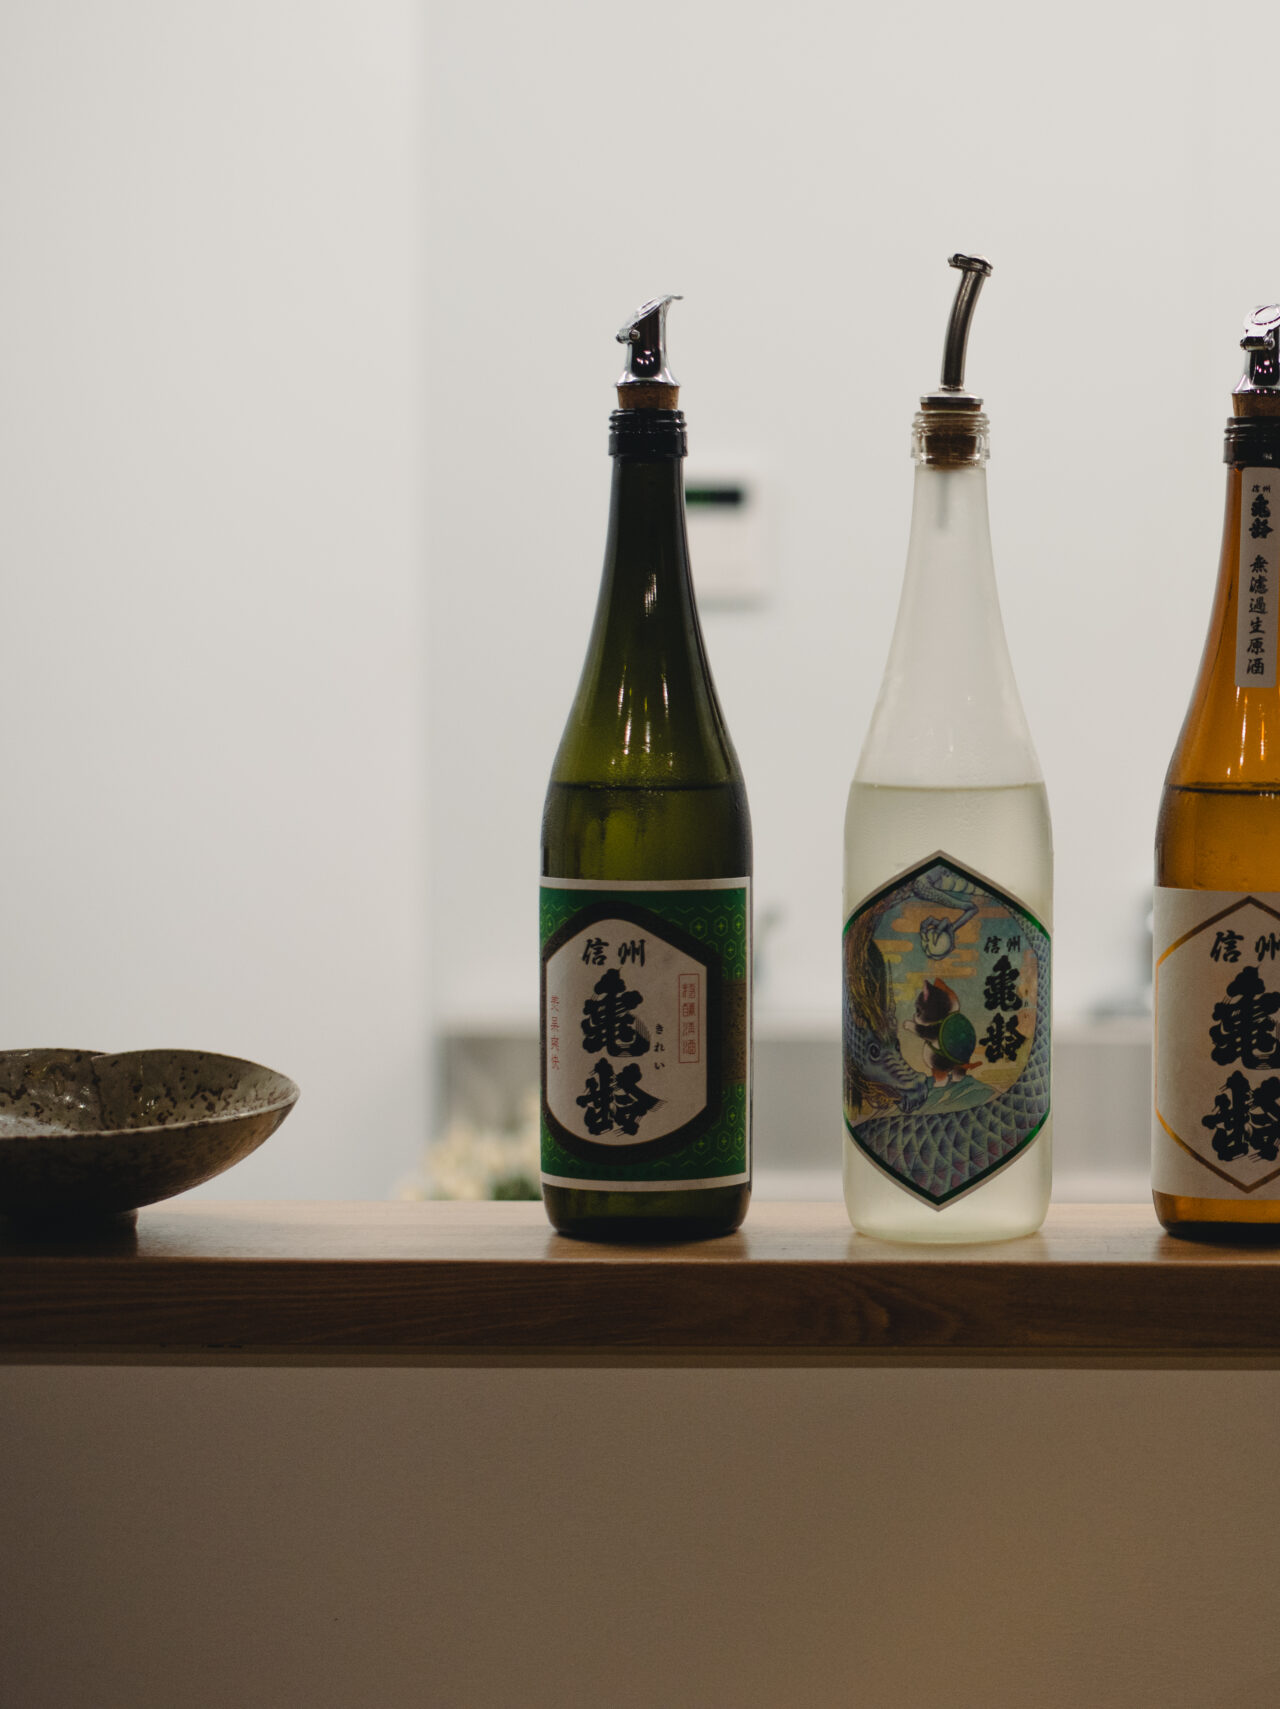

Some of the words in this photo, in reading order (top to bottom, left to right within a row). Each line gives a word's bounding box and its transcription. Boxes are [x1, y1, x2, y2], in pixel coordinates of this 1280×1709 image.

[1246, 554, 1269, 676] 無濾過生原酒
[581, 937, 646, 967] 信州
[983, 934, 1021, 954] 信州
[653, 1023, 666, 1070] きれい
